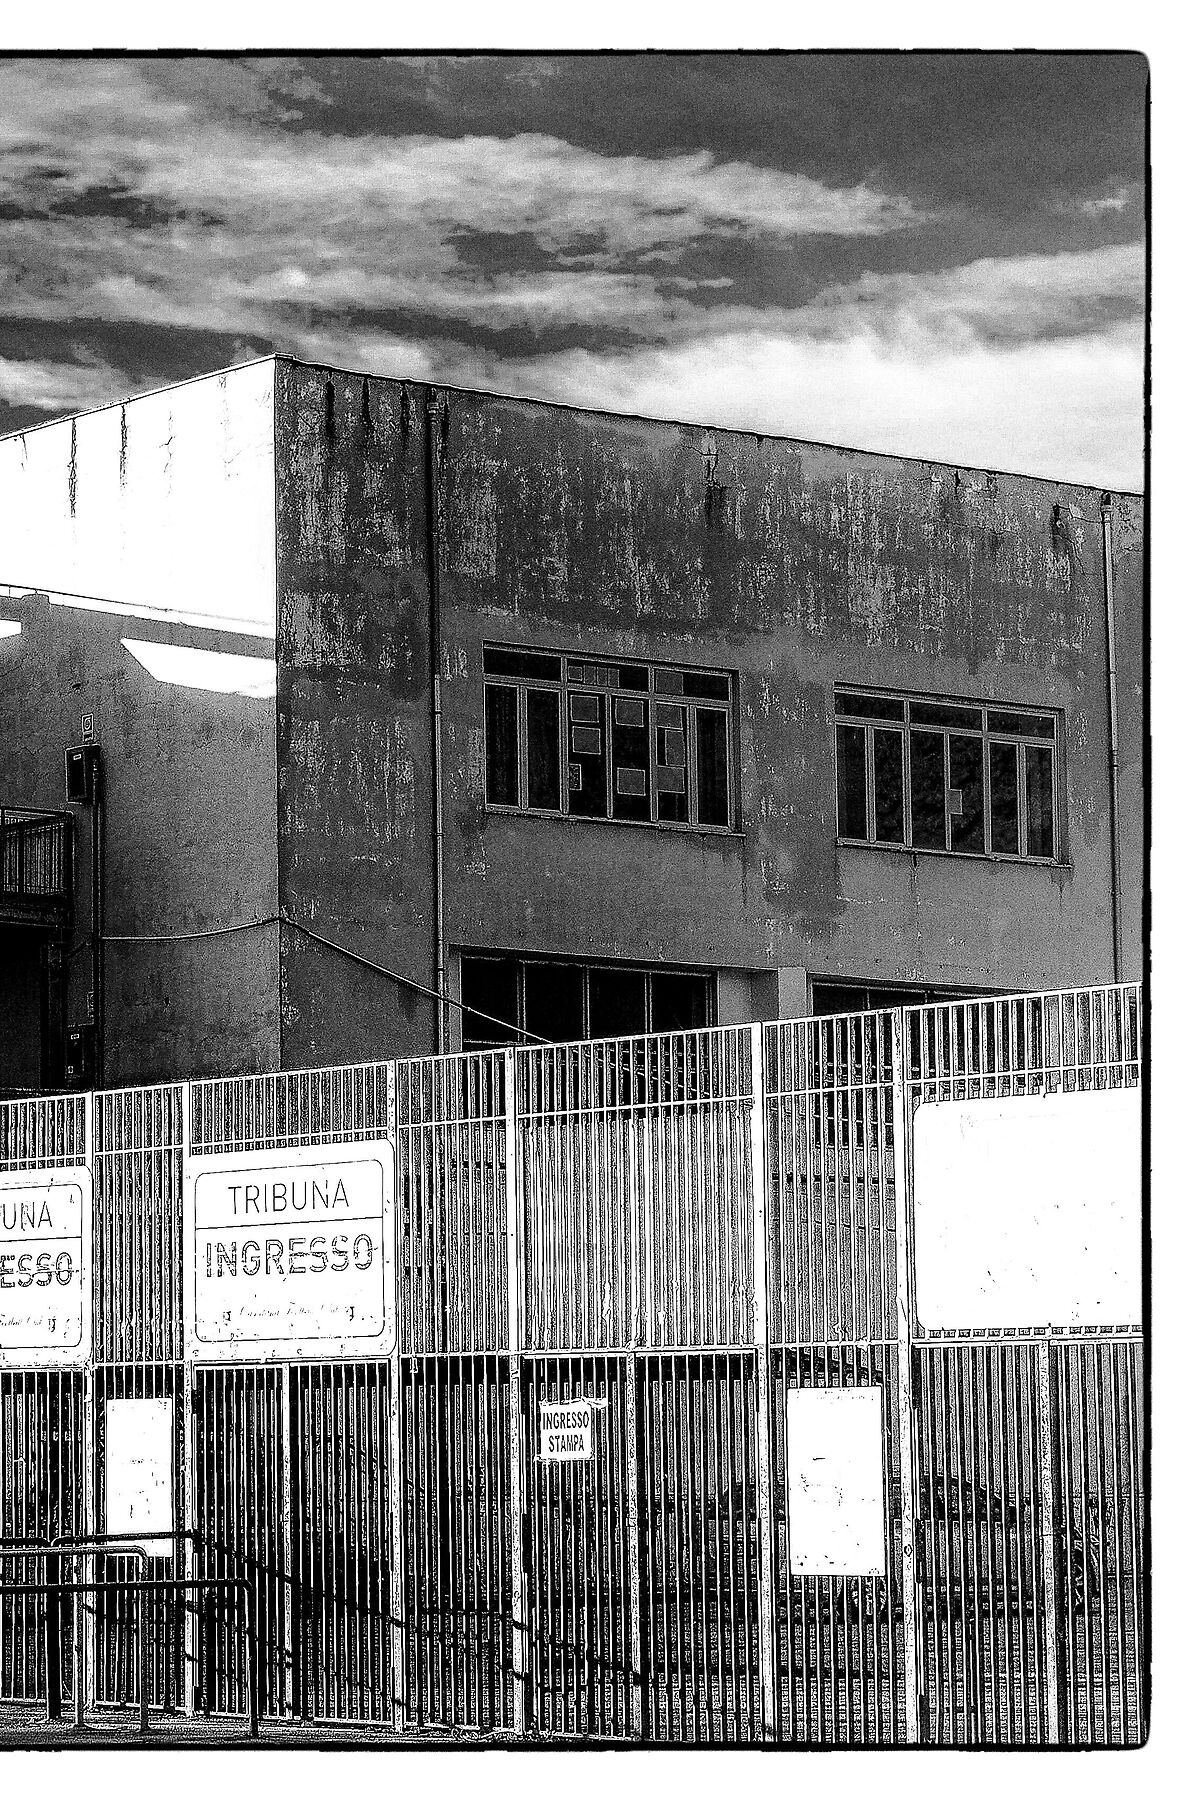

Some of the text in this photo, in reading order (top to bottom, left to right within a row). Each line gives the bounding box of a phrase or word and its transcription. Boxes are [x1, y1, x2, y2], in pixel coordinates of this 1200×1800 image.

[228, 1178, 349, 1215] TRIBUNA
[205, 1233, 374, 1278] INGRESSO
[542, 1410, 590, 1430] INGRESSO
[548, 1433, 585, 1453] STAMPA
